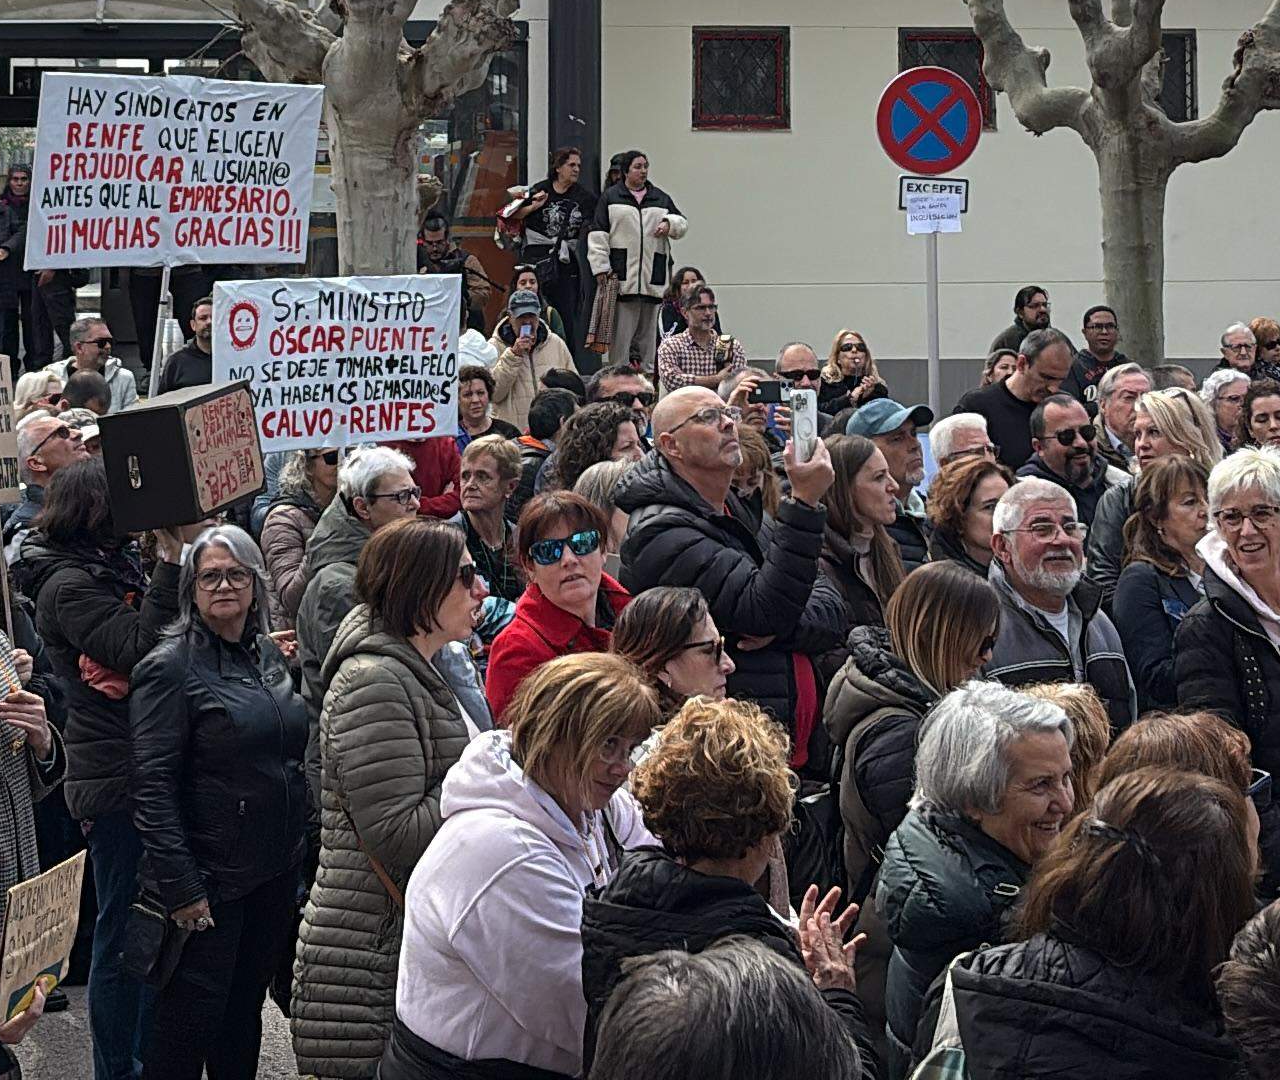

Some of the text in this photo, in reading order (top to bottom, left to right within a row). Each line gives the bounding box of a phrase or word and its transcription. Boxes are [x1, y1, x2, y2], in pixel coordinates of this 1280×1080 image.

[66, 86, 288, 123] HAY SINDICATOS EN
[66, 122, 285, 159] RENFE QUE ELIGEN
[49, 152, 291, 186] PERJUDICAR AL USUARI@
[40, 182, 298, 217] ANTES QUE AL EMPRESARIO,
[906, 183, 963, 195] EXCEPTE
[175, 215, 302, 255] GRACIAS!!!
[271, 287, 426, 322] Sr. MINISTRO
[229, 366, 255, 383] NO
[261, 360, 284, 383] SE
[286, 357, 330, 381] DEJE
[252, 387, 273, 408] YA
[261, 406, 334, 439] CALVO
